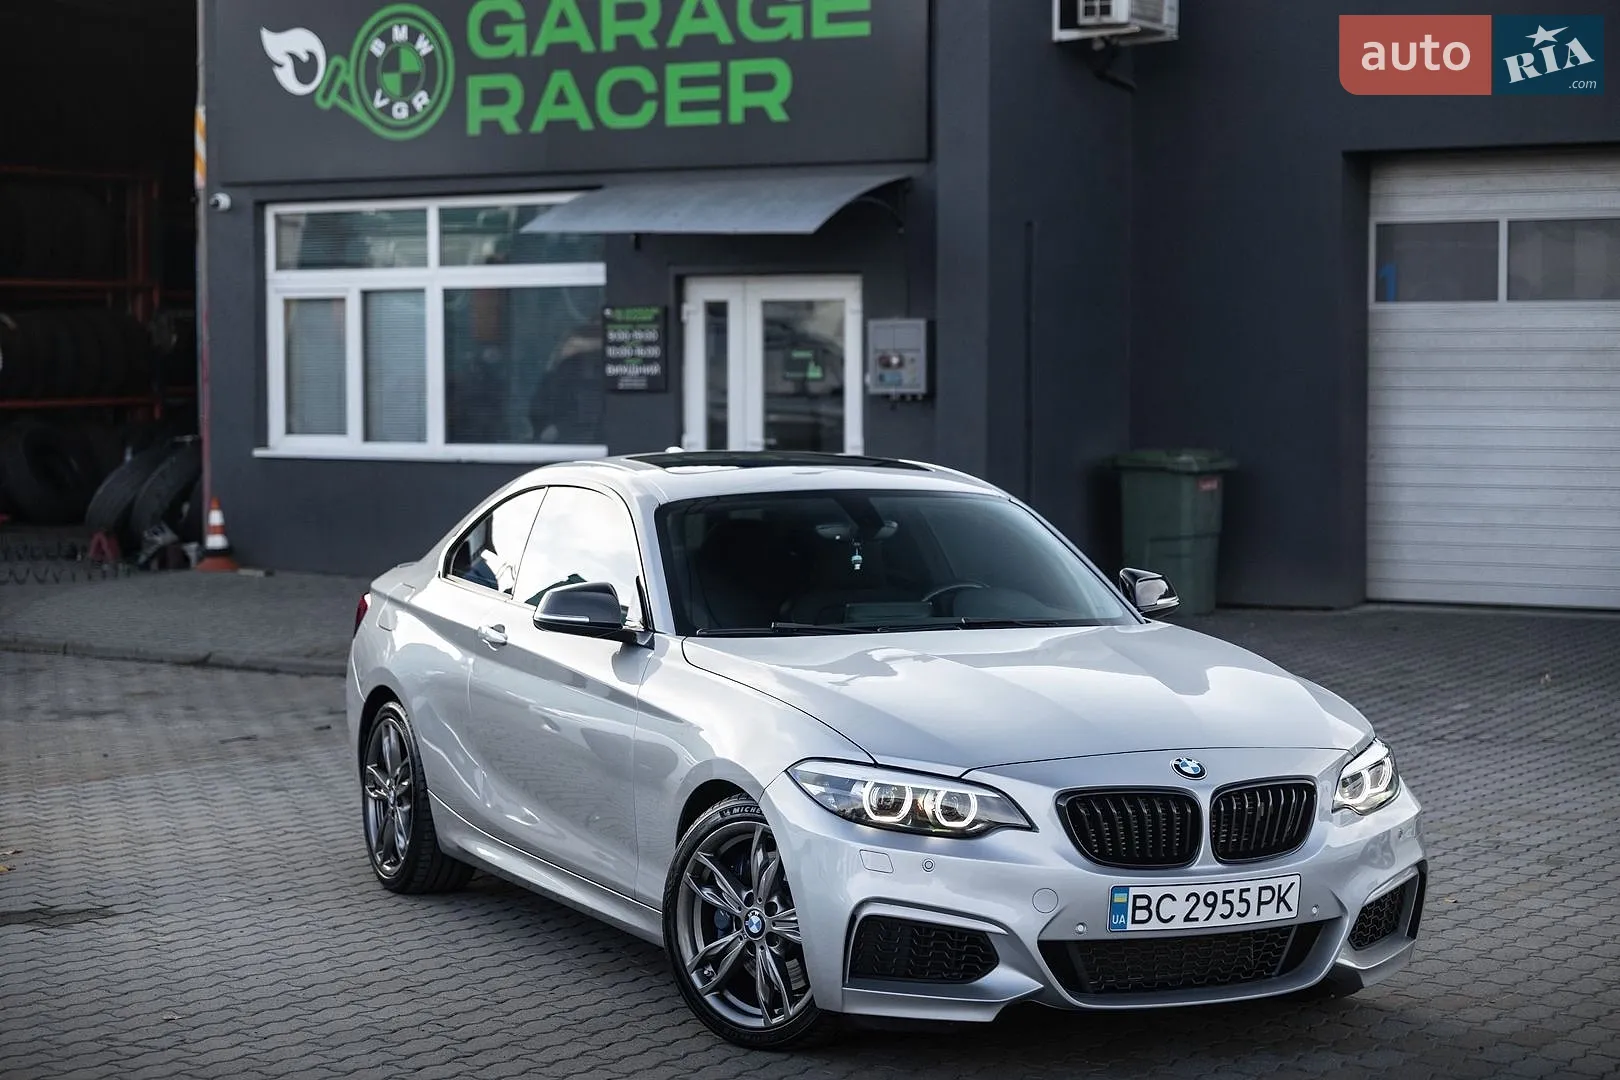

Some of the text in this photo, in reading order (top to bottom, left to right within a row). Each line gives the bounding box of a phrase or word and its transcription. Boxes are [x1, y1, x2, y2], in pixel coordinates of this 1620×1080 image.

[370, 24, 434, 58] BMW
[467, 0, 871, 59] GARAGE
[373, 88, 430, 120] VGR
[466, 58, 793, 136] RACER
[1112, 914, 1126, 925] UA
[1131, 882, 1295, 925] BC 2955 PK
